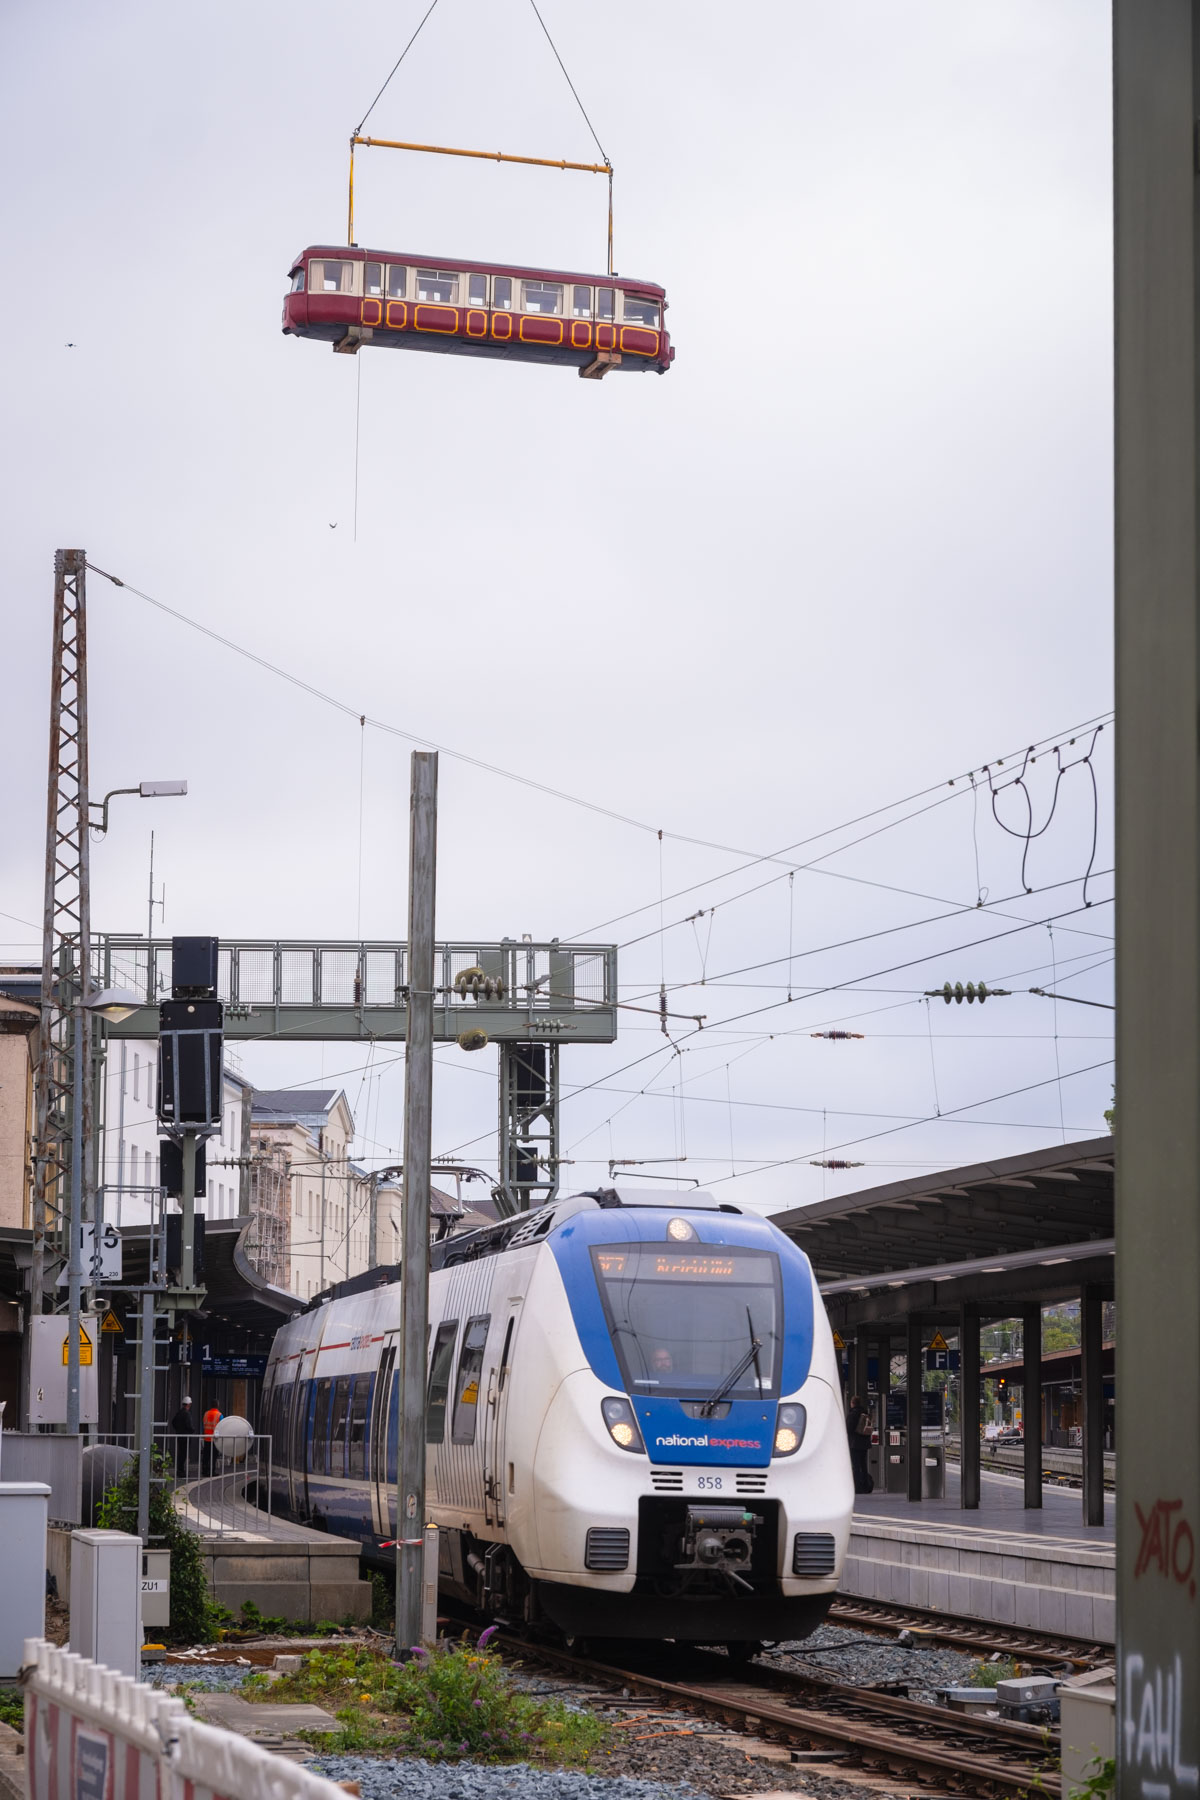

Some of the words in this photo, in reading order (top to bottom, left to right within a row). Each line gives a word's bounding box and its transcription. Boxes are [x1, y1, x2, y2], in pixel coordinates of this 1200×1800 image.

[89, 1255, 103, 1276] 2
[202, 1344, 212, 1360] 1
[935, 1352, 946, 1368] F
[656, 1434, 708, 1446] national
[709, 1438, 761, 1449] express
[698, 1476, 722, 1489] 858
